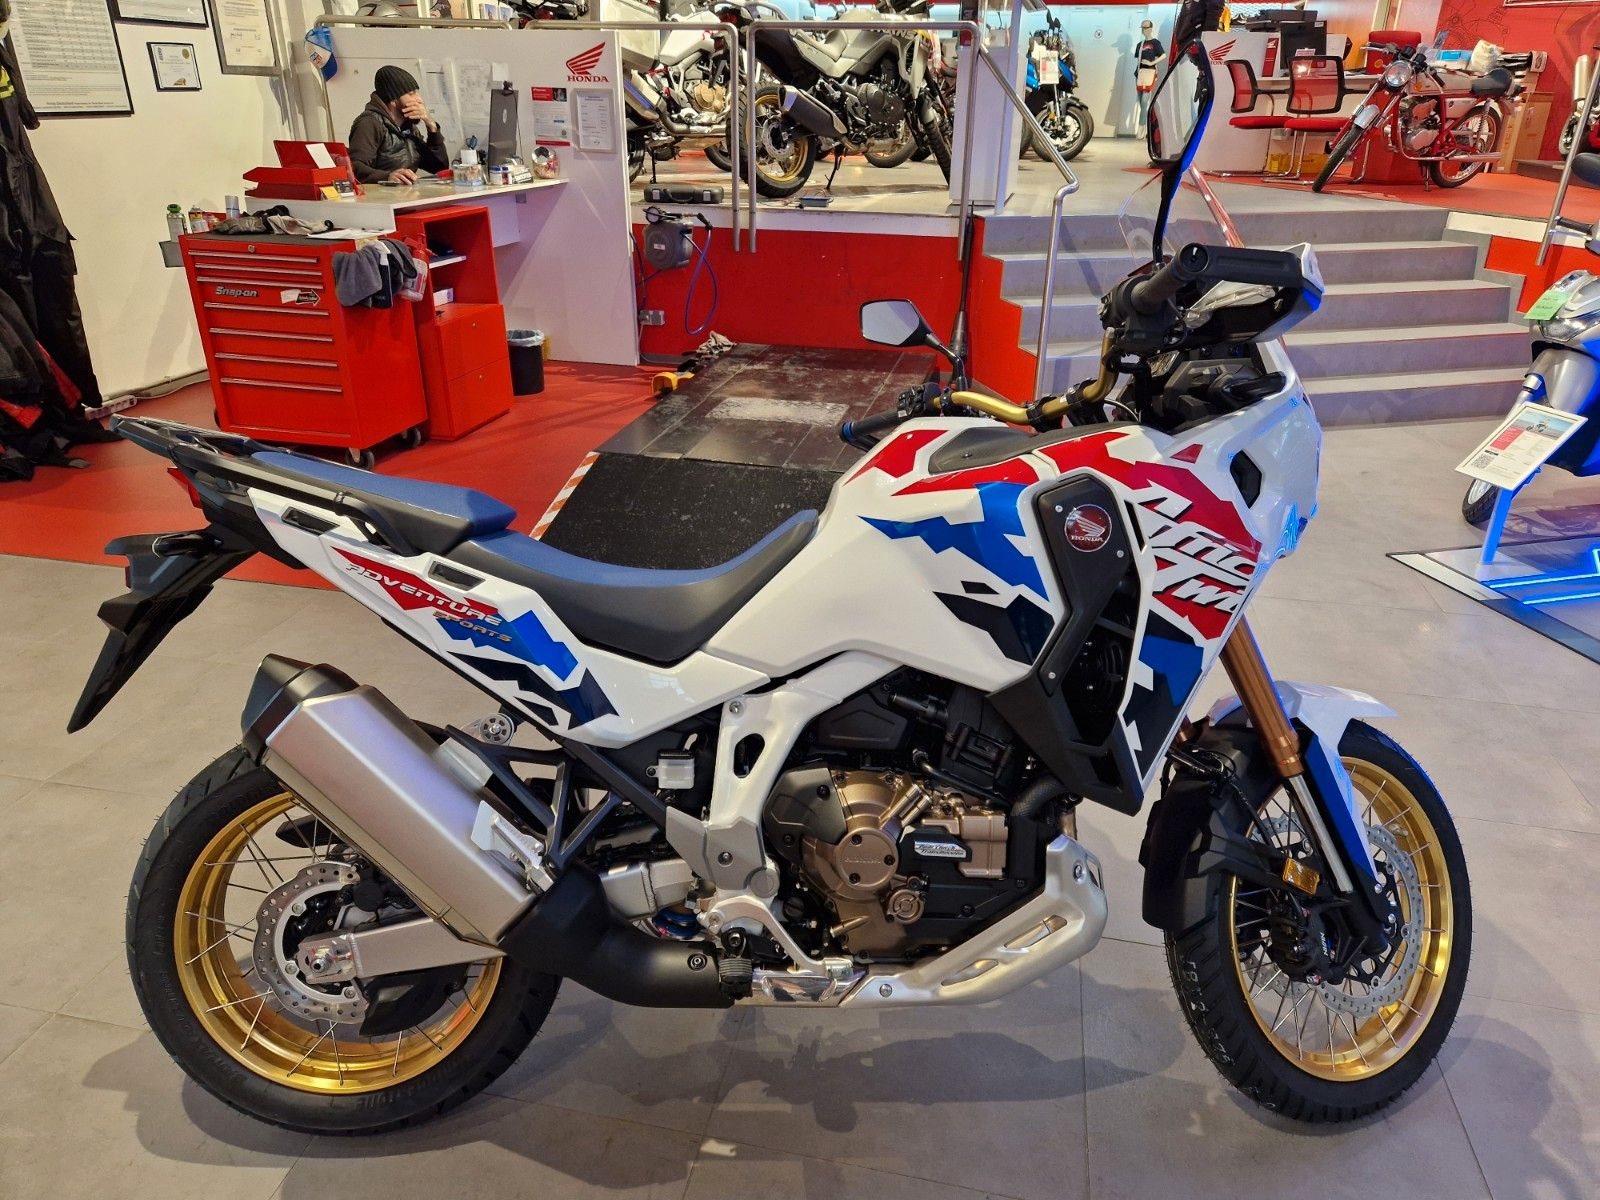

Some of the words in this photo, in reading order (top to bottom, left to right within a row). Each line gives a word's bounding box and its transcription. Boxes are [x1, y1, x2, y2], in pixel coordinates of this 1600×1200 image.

[567, 75, 609, 83] HONDA
[215, 285, 257, 297] Snap-on
[346, 564, 502, 626] ADVENTURE
[433, 611, 513, 643] SPORTS
